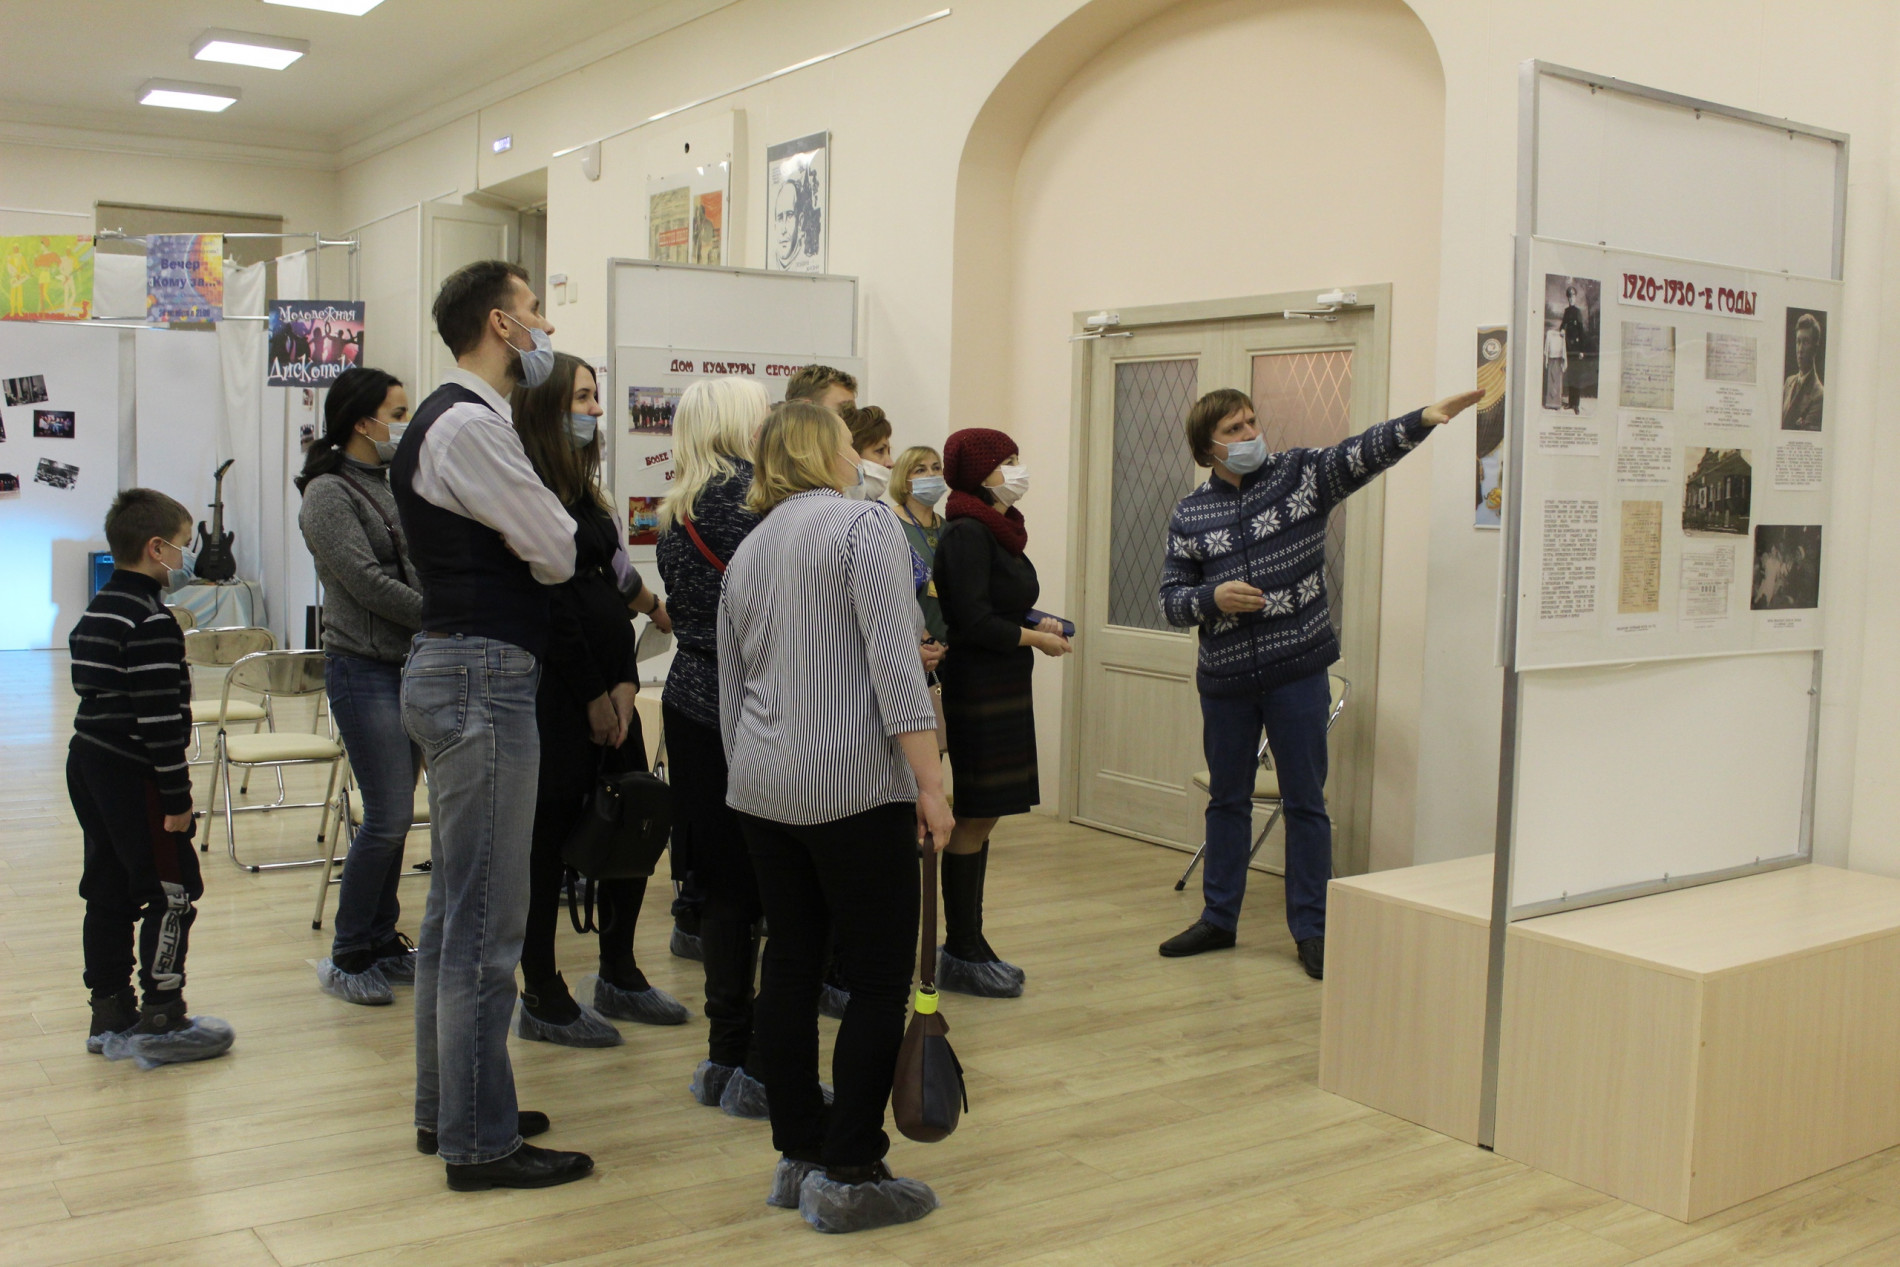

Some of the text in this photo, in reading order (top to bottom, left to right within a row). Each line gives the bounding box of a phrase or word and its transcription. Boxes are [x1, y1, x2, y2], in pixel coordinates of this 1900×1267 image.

[161, 258, 200, 271] Вечер
[1717, 286, 1757, 316] ГОДЫ
[670, 359, 694, 373] ДОМ
[702, 361, 756, 375] КУЛЬТУРЫ
[645, 451, 669, 466] БОЛЕЕ
